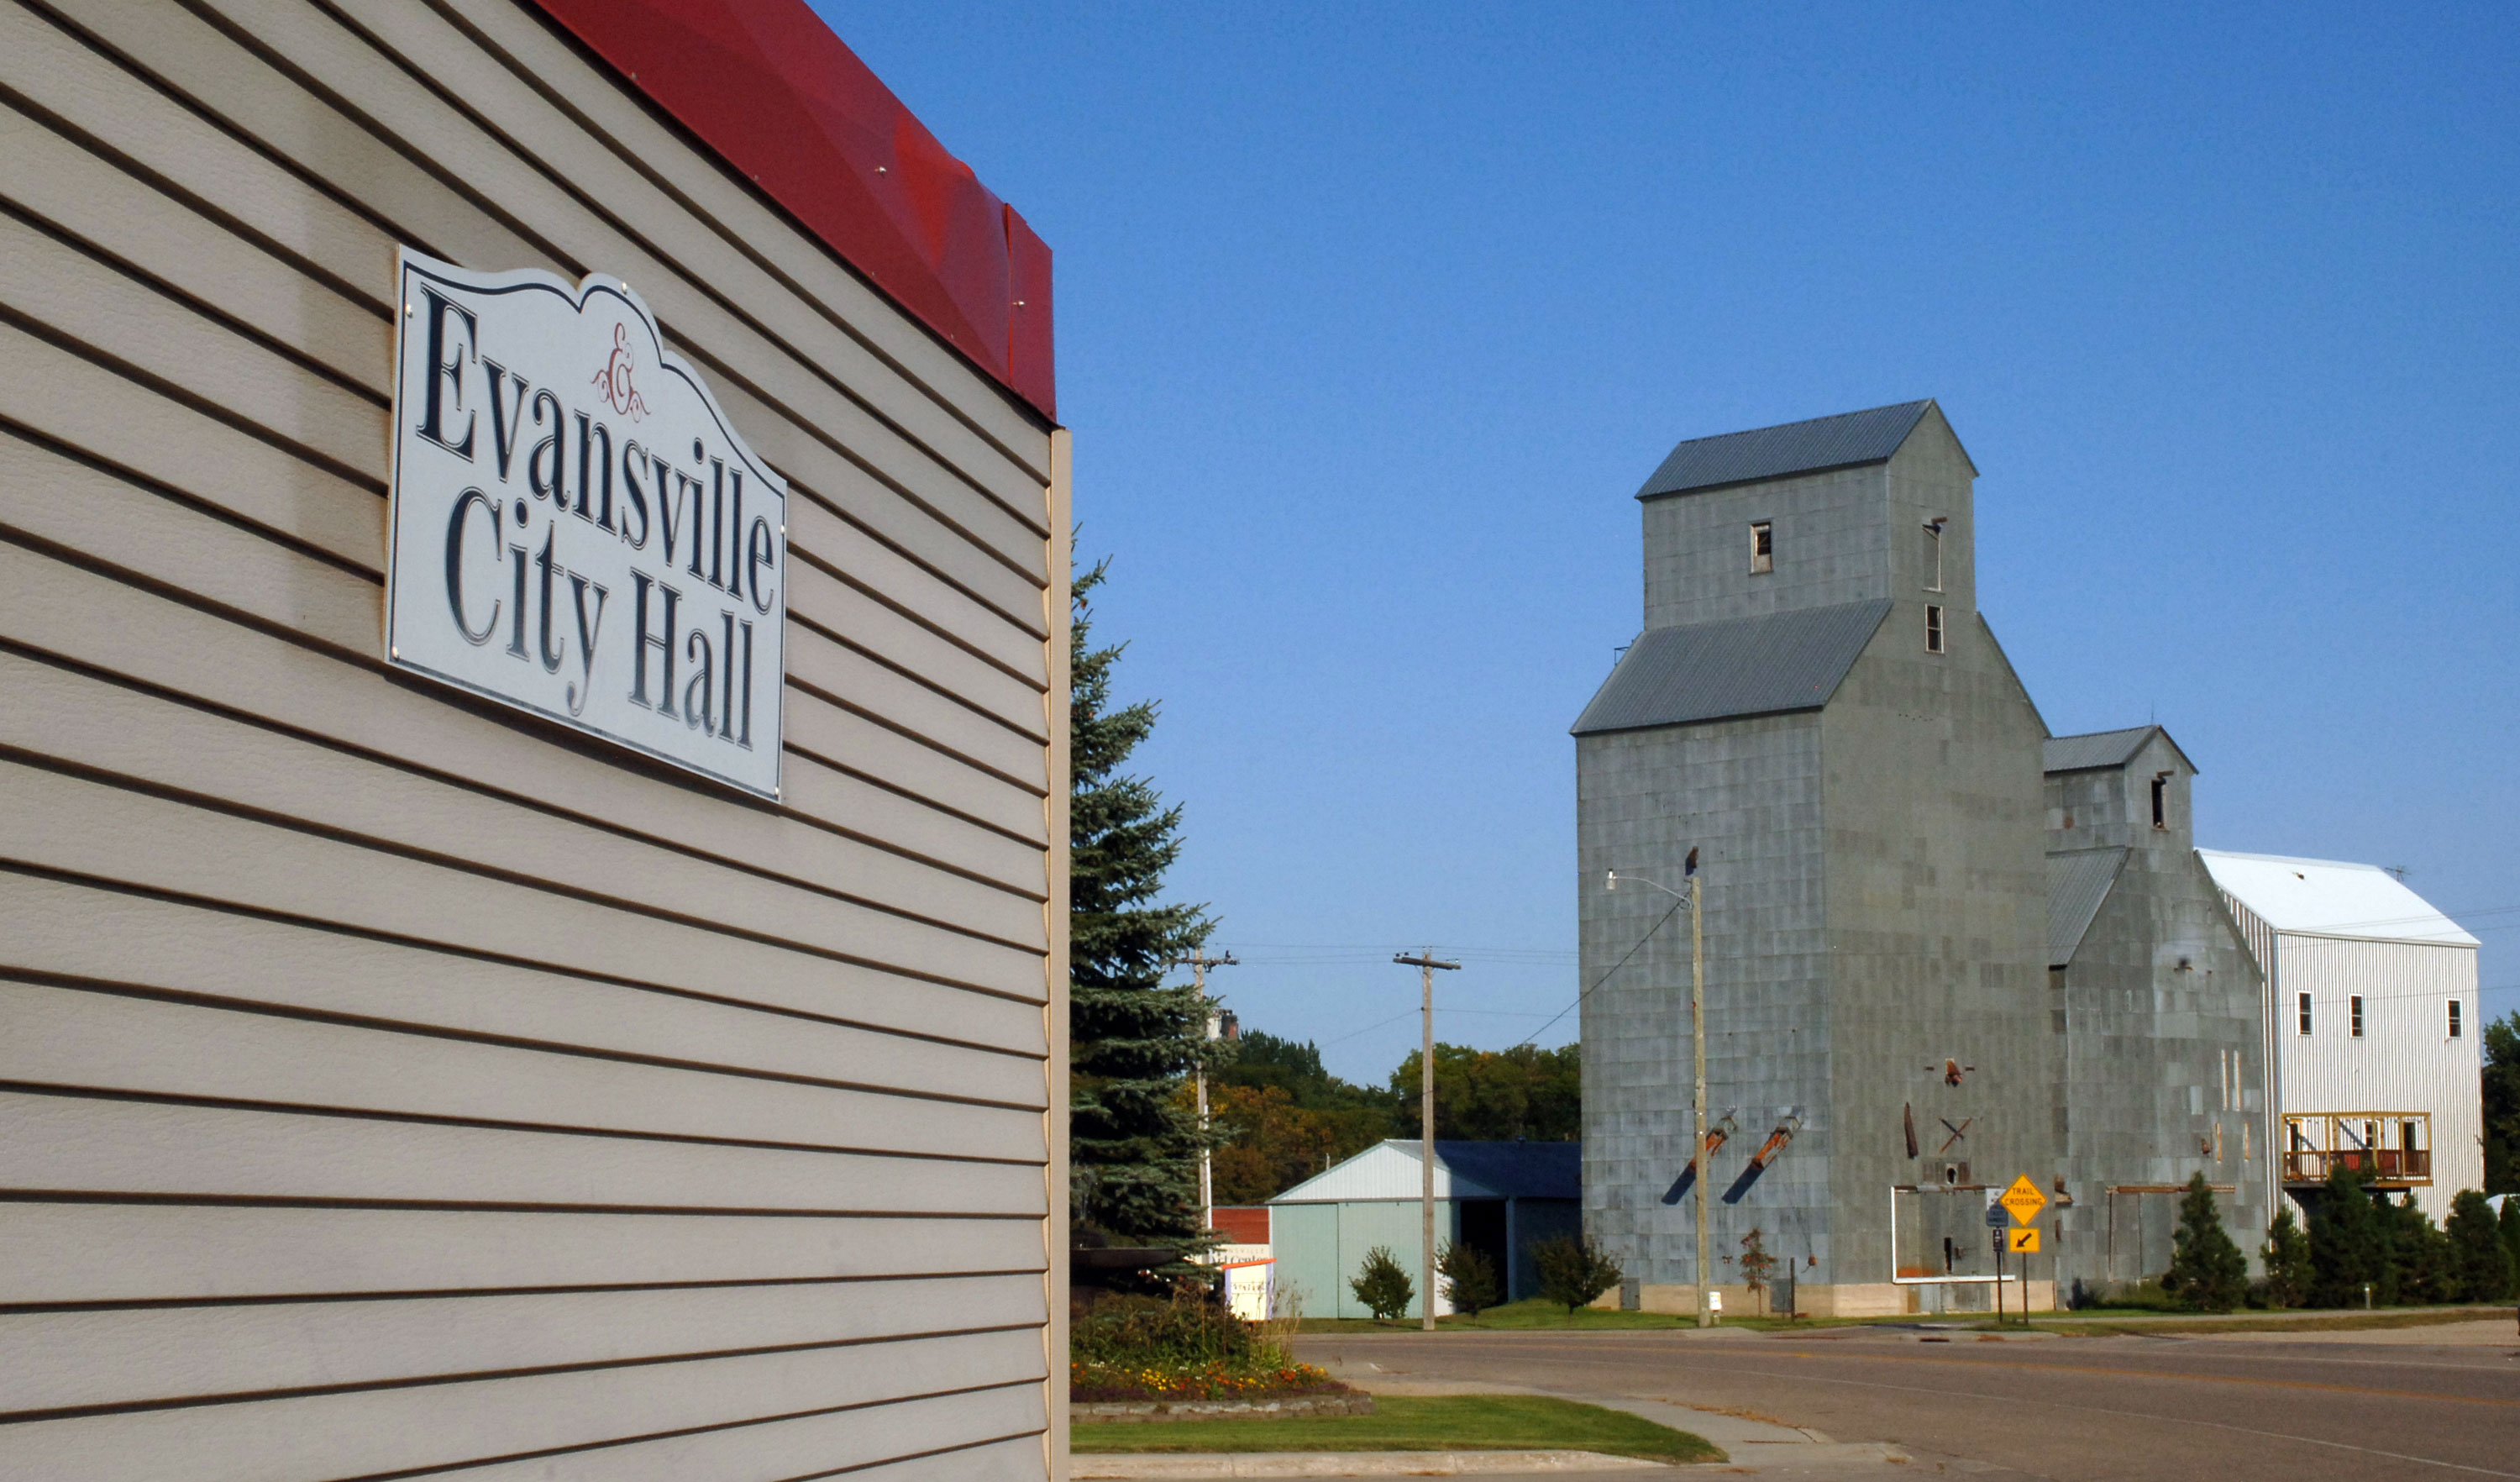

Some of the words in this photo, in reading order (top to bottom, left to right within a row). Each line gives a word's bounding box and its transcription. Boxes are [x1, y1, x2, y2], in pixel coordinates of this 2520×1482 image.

[416, 281, 774, 615] Evansville
[445, 486, 609, 716] City
[627, 566, 754, 752] Hall
